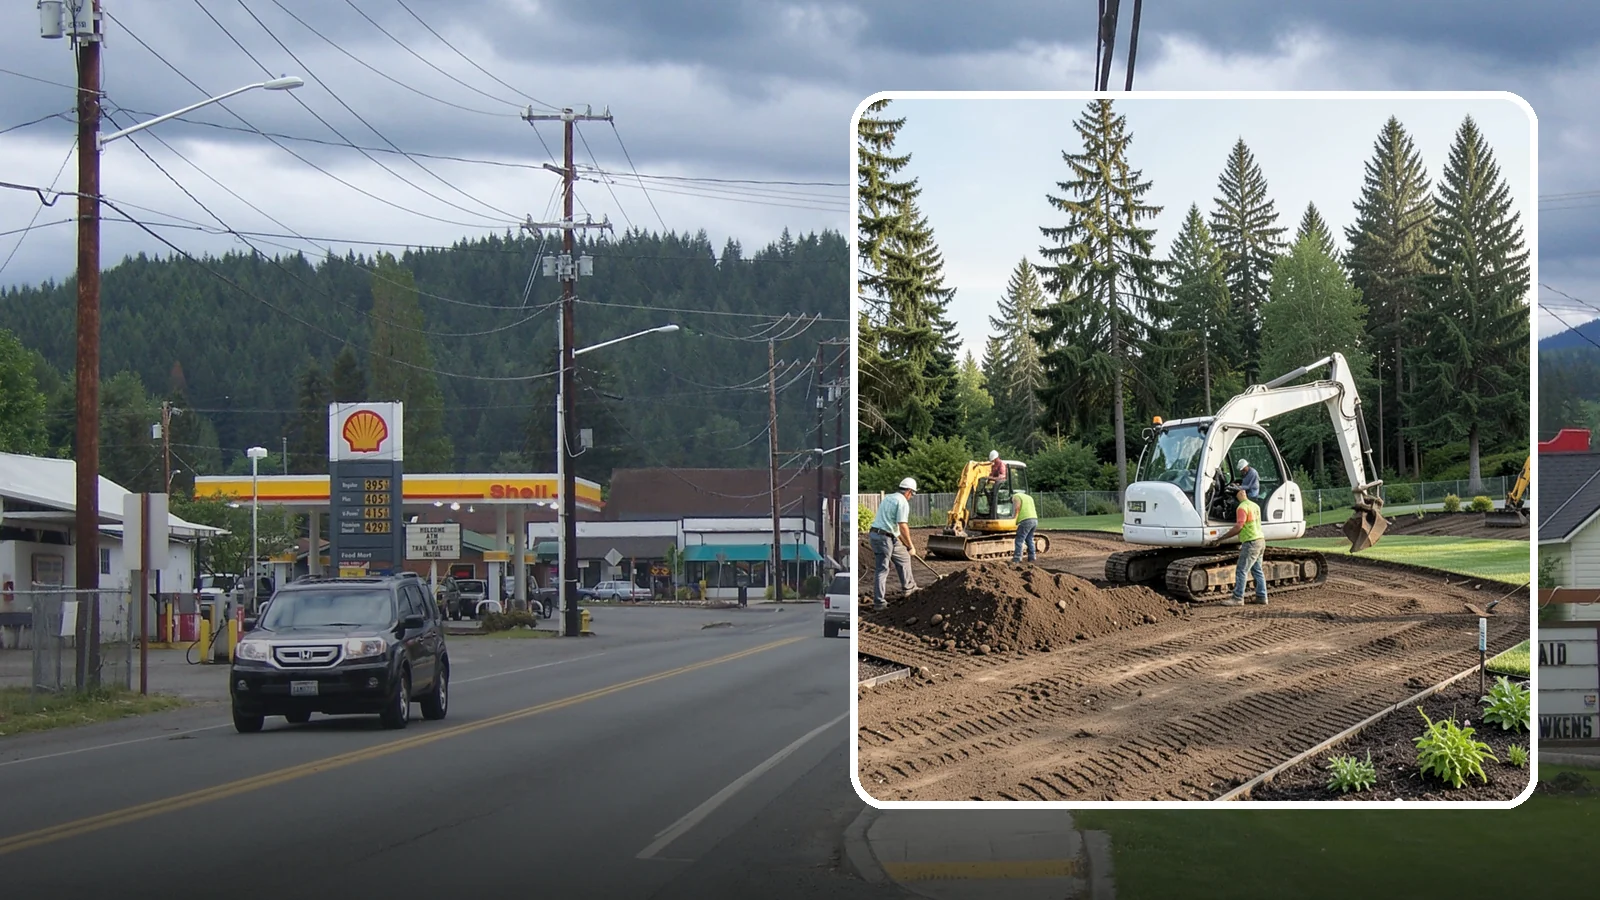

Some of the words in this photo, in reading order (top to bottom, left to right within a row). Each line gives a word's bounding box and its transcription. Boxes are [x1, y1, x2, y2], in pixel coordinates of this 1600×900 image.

[366, 480, 383, 490] 395
[489, 484, 547, 499] Shell
[365, 494, 383, 504] 405
[365, 508, 383, 518] 415
[366, 522, 383, 532] 429
[1538, 643, 1567, 665] AID
